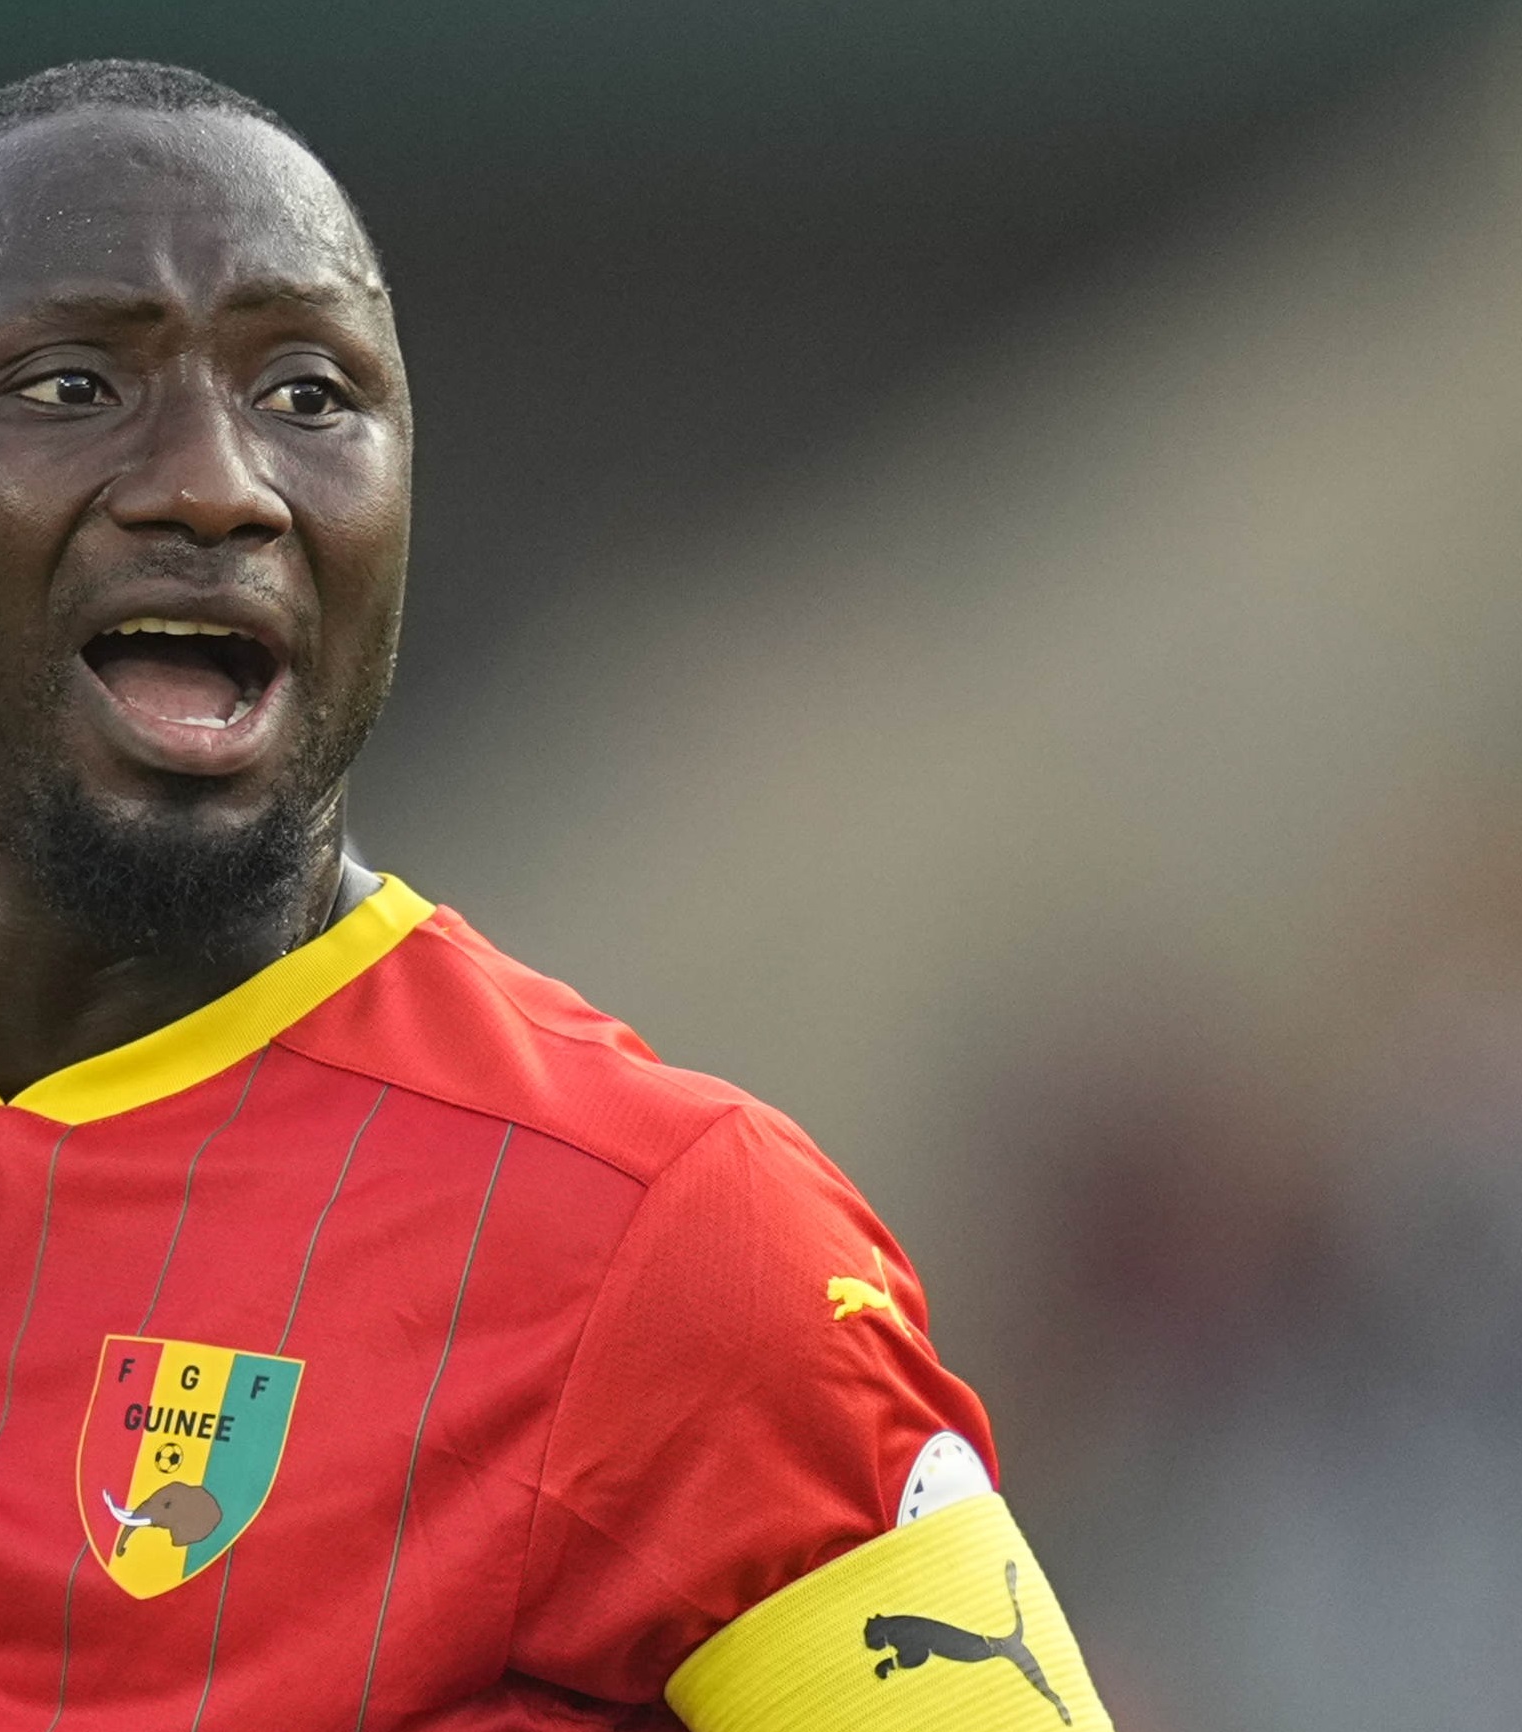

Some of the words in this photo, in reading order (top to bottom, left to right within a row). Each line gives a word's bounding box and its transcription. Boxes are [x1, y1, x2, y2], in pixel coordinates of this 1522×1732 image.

[118, 1358, 135, 1383] F
[181, 1365, 200, 1390] G
[250, 1375, 270, 1400] F
[124, 1404, 235, 1442] GUINEE
